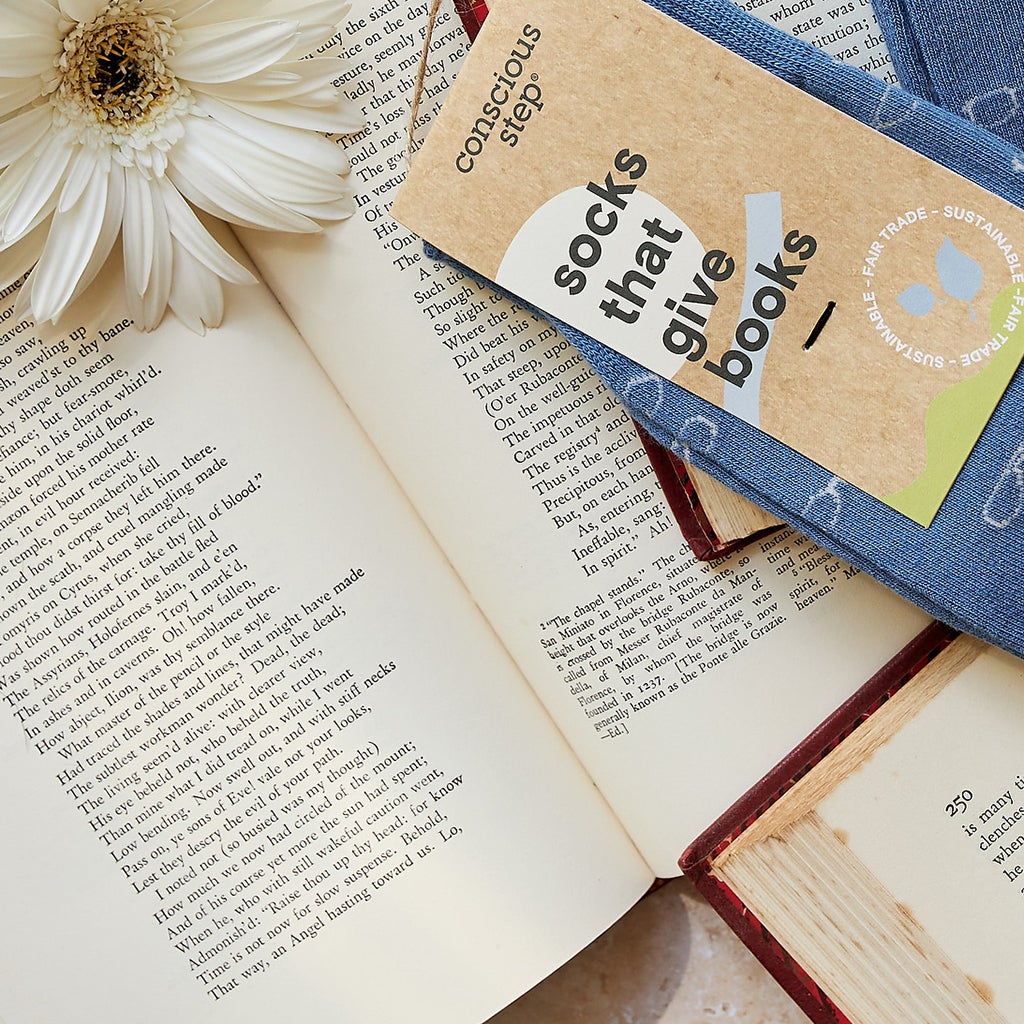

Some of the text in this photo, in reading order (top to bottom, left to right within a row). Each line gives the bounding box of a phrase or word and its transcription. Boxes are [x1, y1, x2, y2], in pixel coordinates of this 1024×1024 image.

[455, 23, 541, 173] conscious
[553, 148, 647, 295] socks
[598, 217, 683, 324] that
[862, 206, 1024, 368] FAIR TRADE SUSTAINABLE FAIR TRADE SUSTAINABLE
[662, 249, 735, 362] give
[702, 229, 817, 389] books
[945, 789, 973, 817] 250
[1002, 865, 1024, 882] he
[206, 826, 463, 1000] That way, an Angel hasting toward us. Lo,
